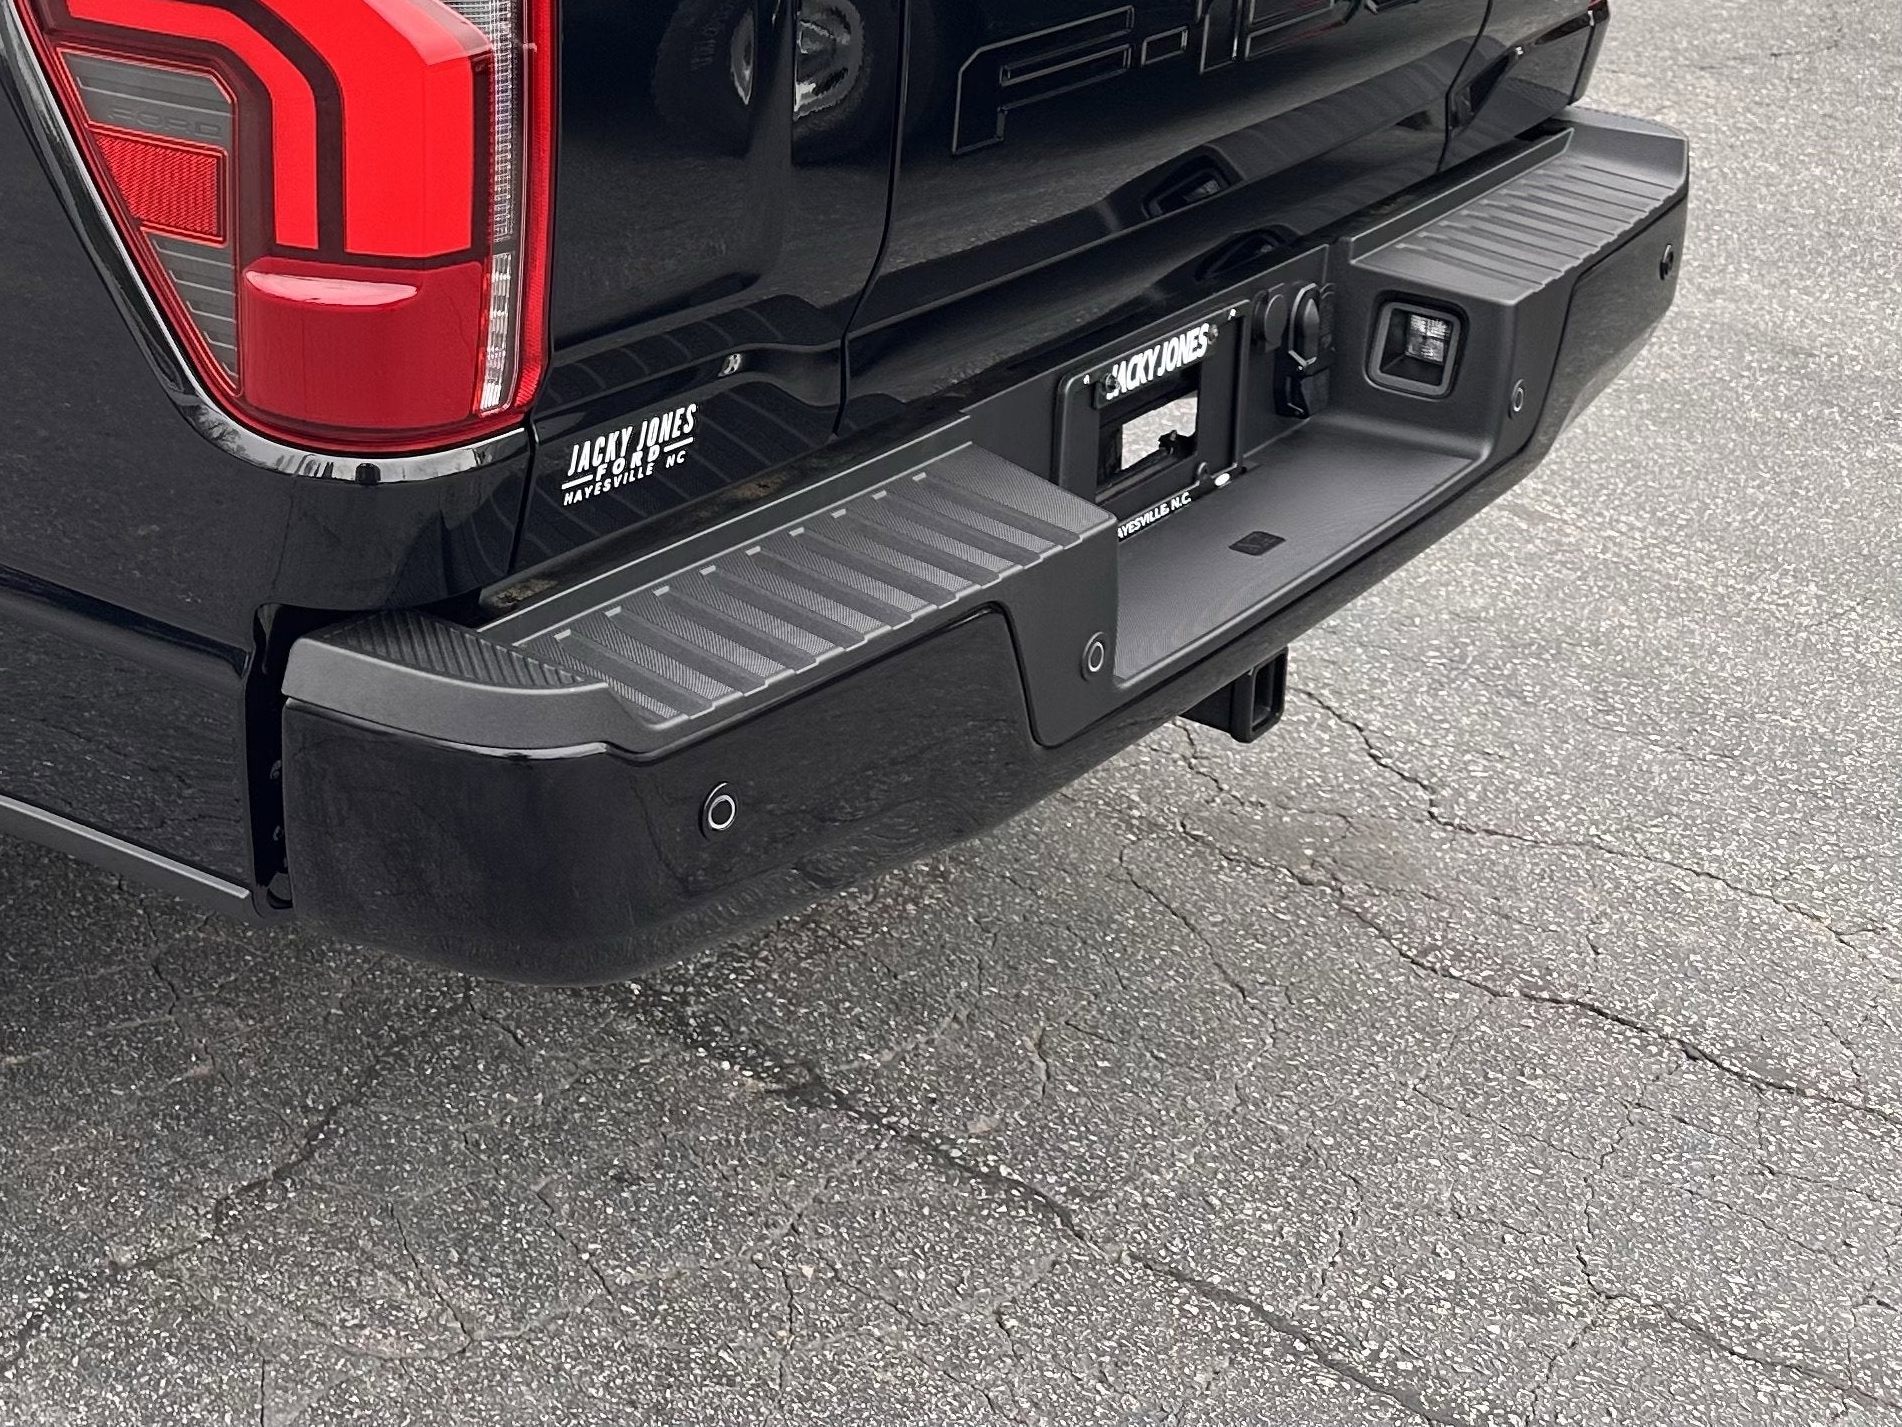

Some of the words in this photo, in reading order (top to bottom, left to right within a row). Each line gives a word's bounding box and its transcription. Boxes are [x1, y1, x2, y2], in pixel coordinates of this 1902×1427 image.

[1105, 344, 1161, 400] JACKY
[1157, 322, 1210, 376] JONES
[566, 425, 633, 477] JACKY
[636, 403, 698, 451] JONES
[595, 444, 661, 482] FORD
[563, 462, 655, 506] HAYESVILLE
[665, 450, 686, 469] NC
[1116, 503, 1170, 539] AYESVILLE,
